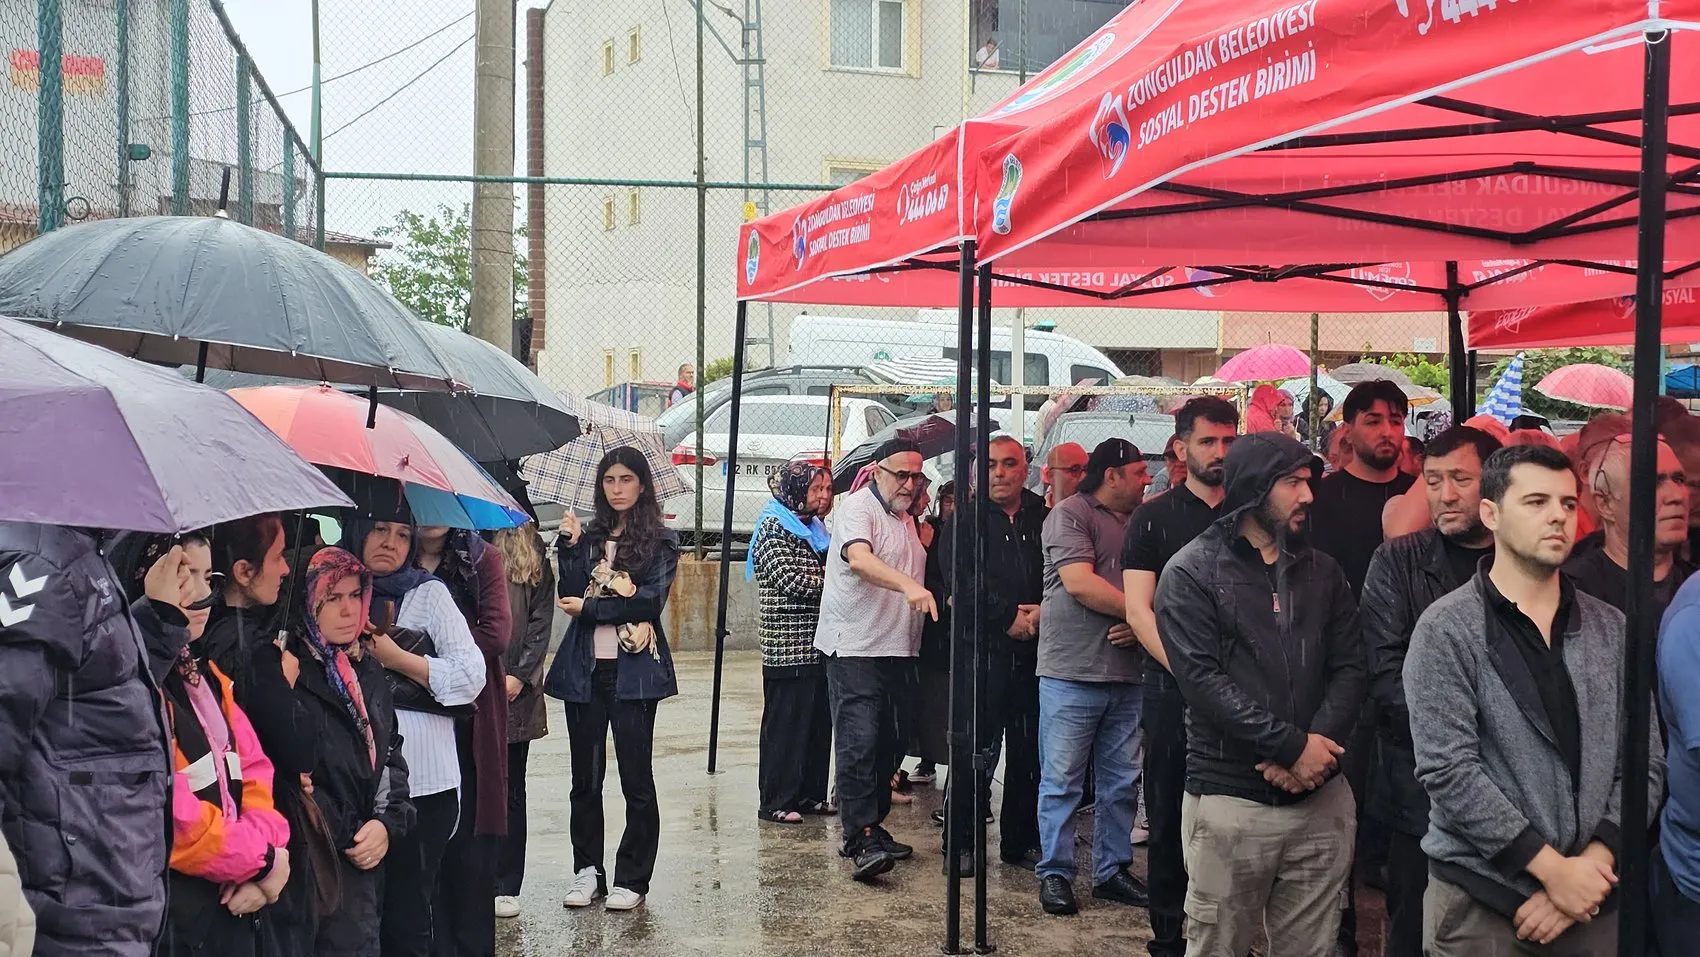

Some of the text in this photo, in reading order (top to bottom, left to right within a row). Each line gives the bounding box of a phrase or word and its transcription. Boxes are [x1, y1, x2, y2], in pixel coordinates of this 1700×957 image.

[1127, 37, 1217, 112] ZONGULDAK
[1138, 41, 1317, 149] SOSYAL DESTEK BİRİMİ
[746, 464, 759, 475] RK
